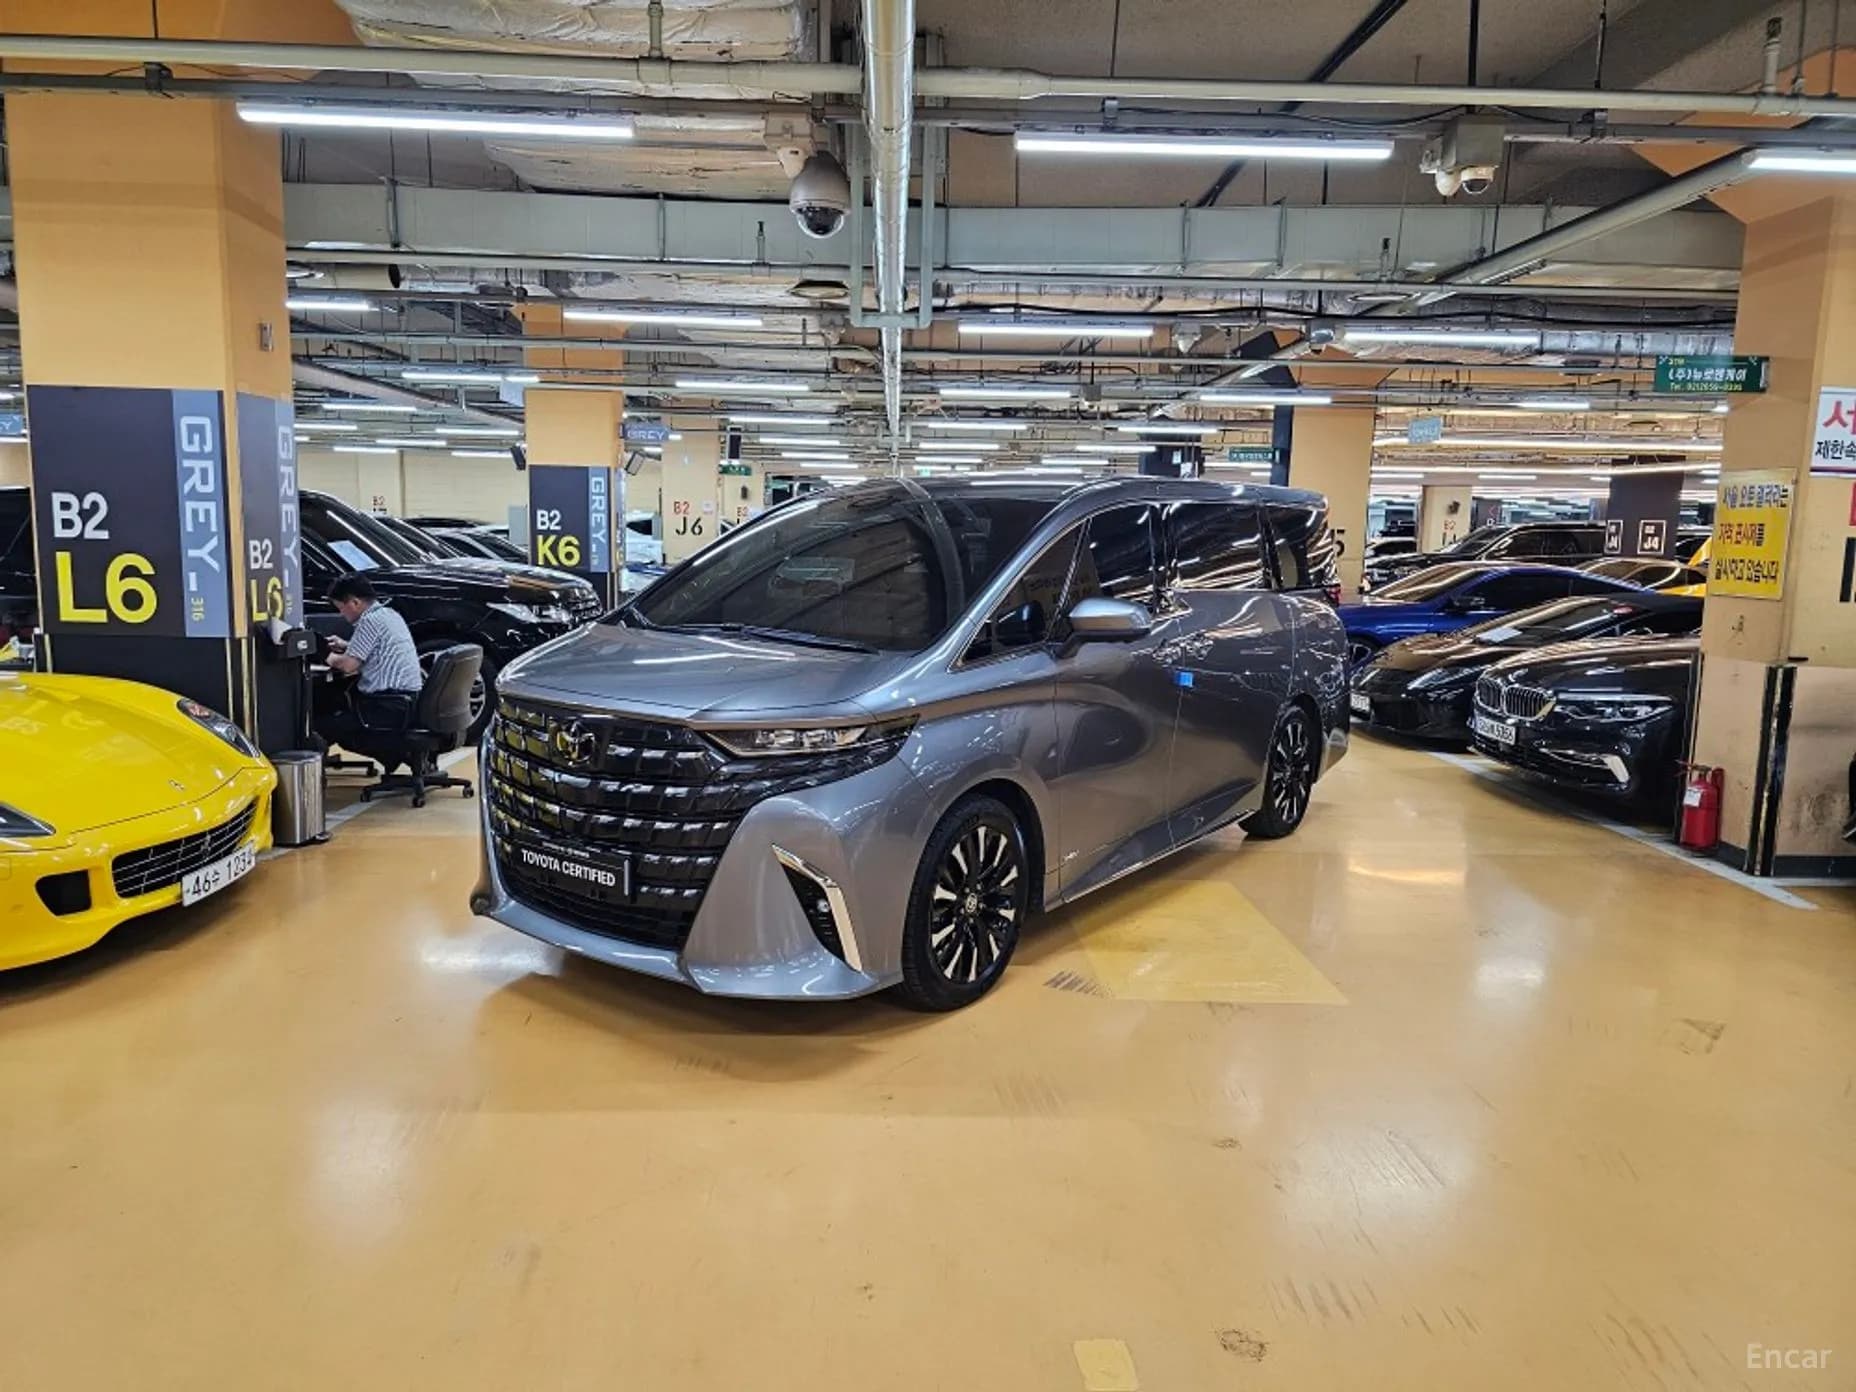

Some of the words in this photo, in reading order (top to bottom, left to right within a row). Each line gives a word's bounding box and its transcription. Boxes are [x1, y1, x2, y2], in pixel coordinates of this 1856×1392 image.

[628, 430, 664, 440] GREY
[51, 491, 110, 540] B2
[536, 510, 562, 530] B2
[674, 501, 689, 515] B2
[675, 516, 703, 536] J6
[249, 539, 273, 570] B2
[536, 534, 581, 567] K6
[1643, 536, 1659, 550] J4
[55, 551, 157, 624] L6
[250, 576, 283, 622] L6
[522, 848, 560, 873] TOYOTA
[562, 861, 616, 887] CERTIFIED
